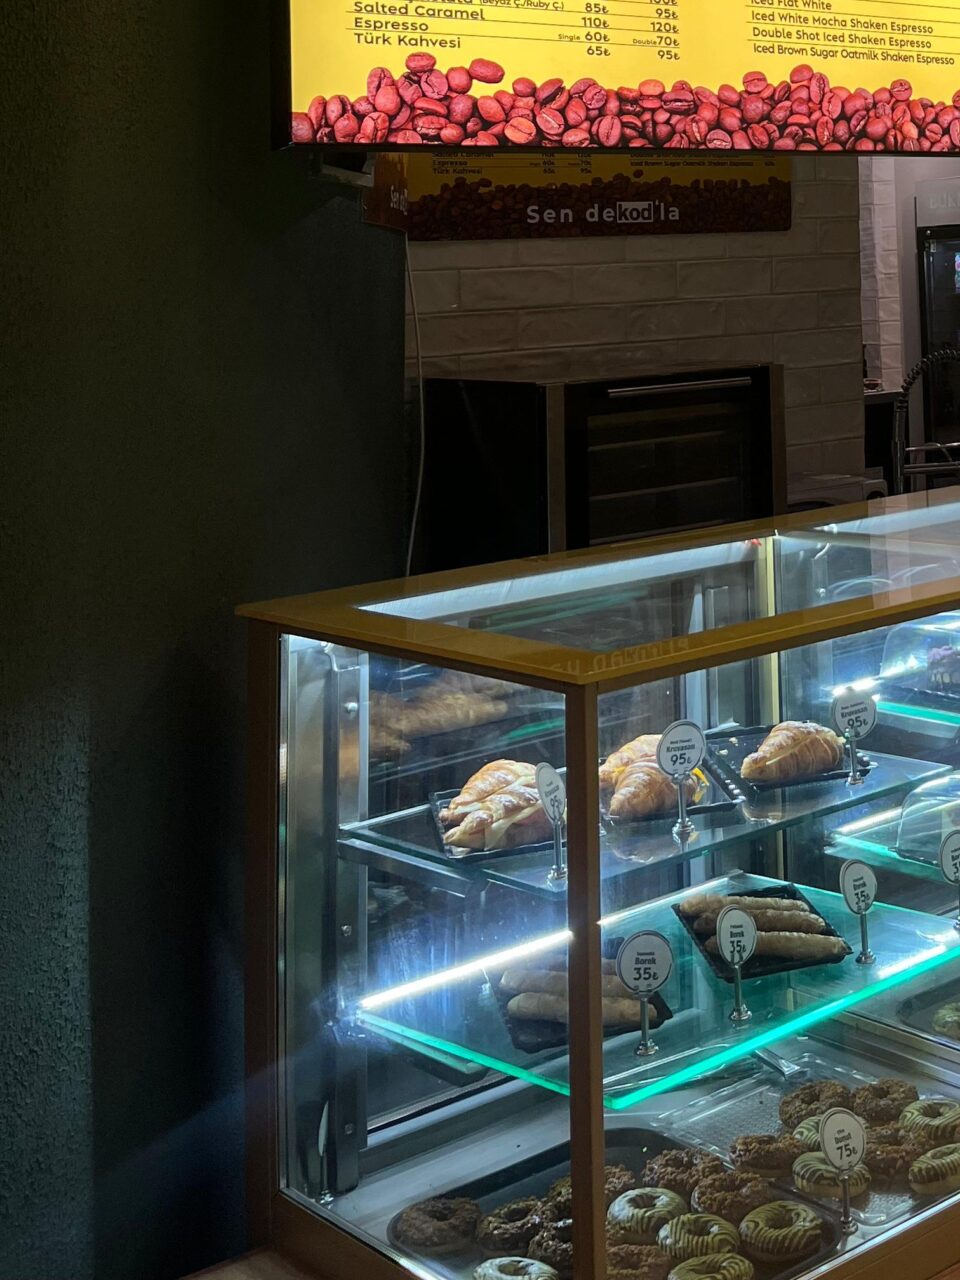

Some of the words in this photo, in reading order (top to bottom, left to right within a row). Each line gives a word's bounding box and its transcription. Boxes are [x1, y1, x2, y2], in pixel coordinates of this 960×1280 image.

[353, 0, 408, 14] Salted
[414, 4, 485, 19] Caramel
[354, 16, 429, 34] Espresso
[353, 31, 392, 45] Türk
[397, 34, 460, 48] Kahvesi
[752, 26, 792, 39] Double
[795, 29, 820, 41] Shot
[822, 31, 845, 42] Iced
[847, 33, 885, 45] Shaken
[888, 36, 932, 53] Espresso
[526, 205, 574, 224] Sen
